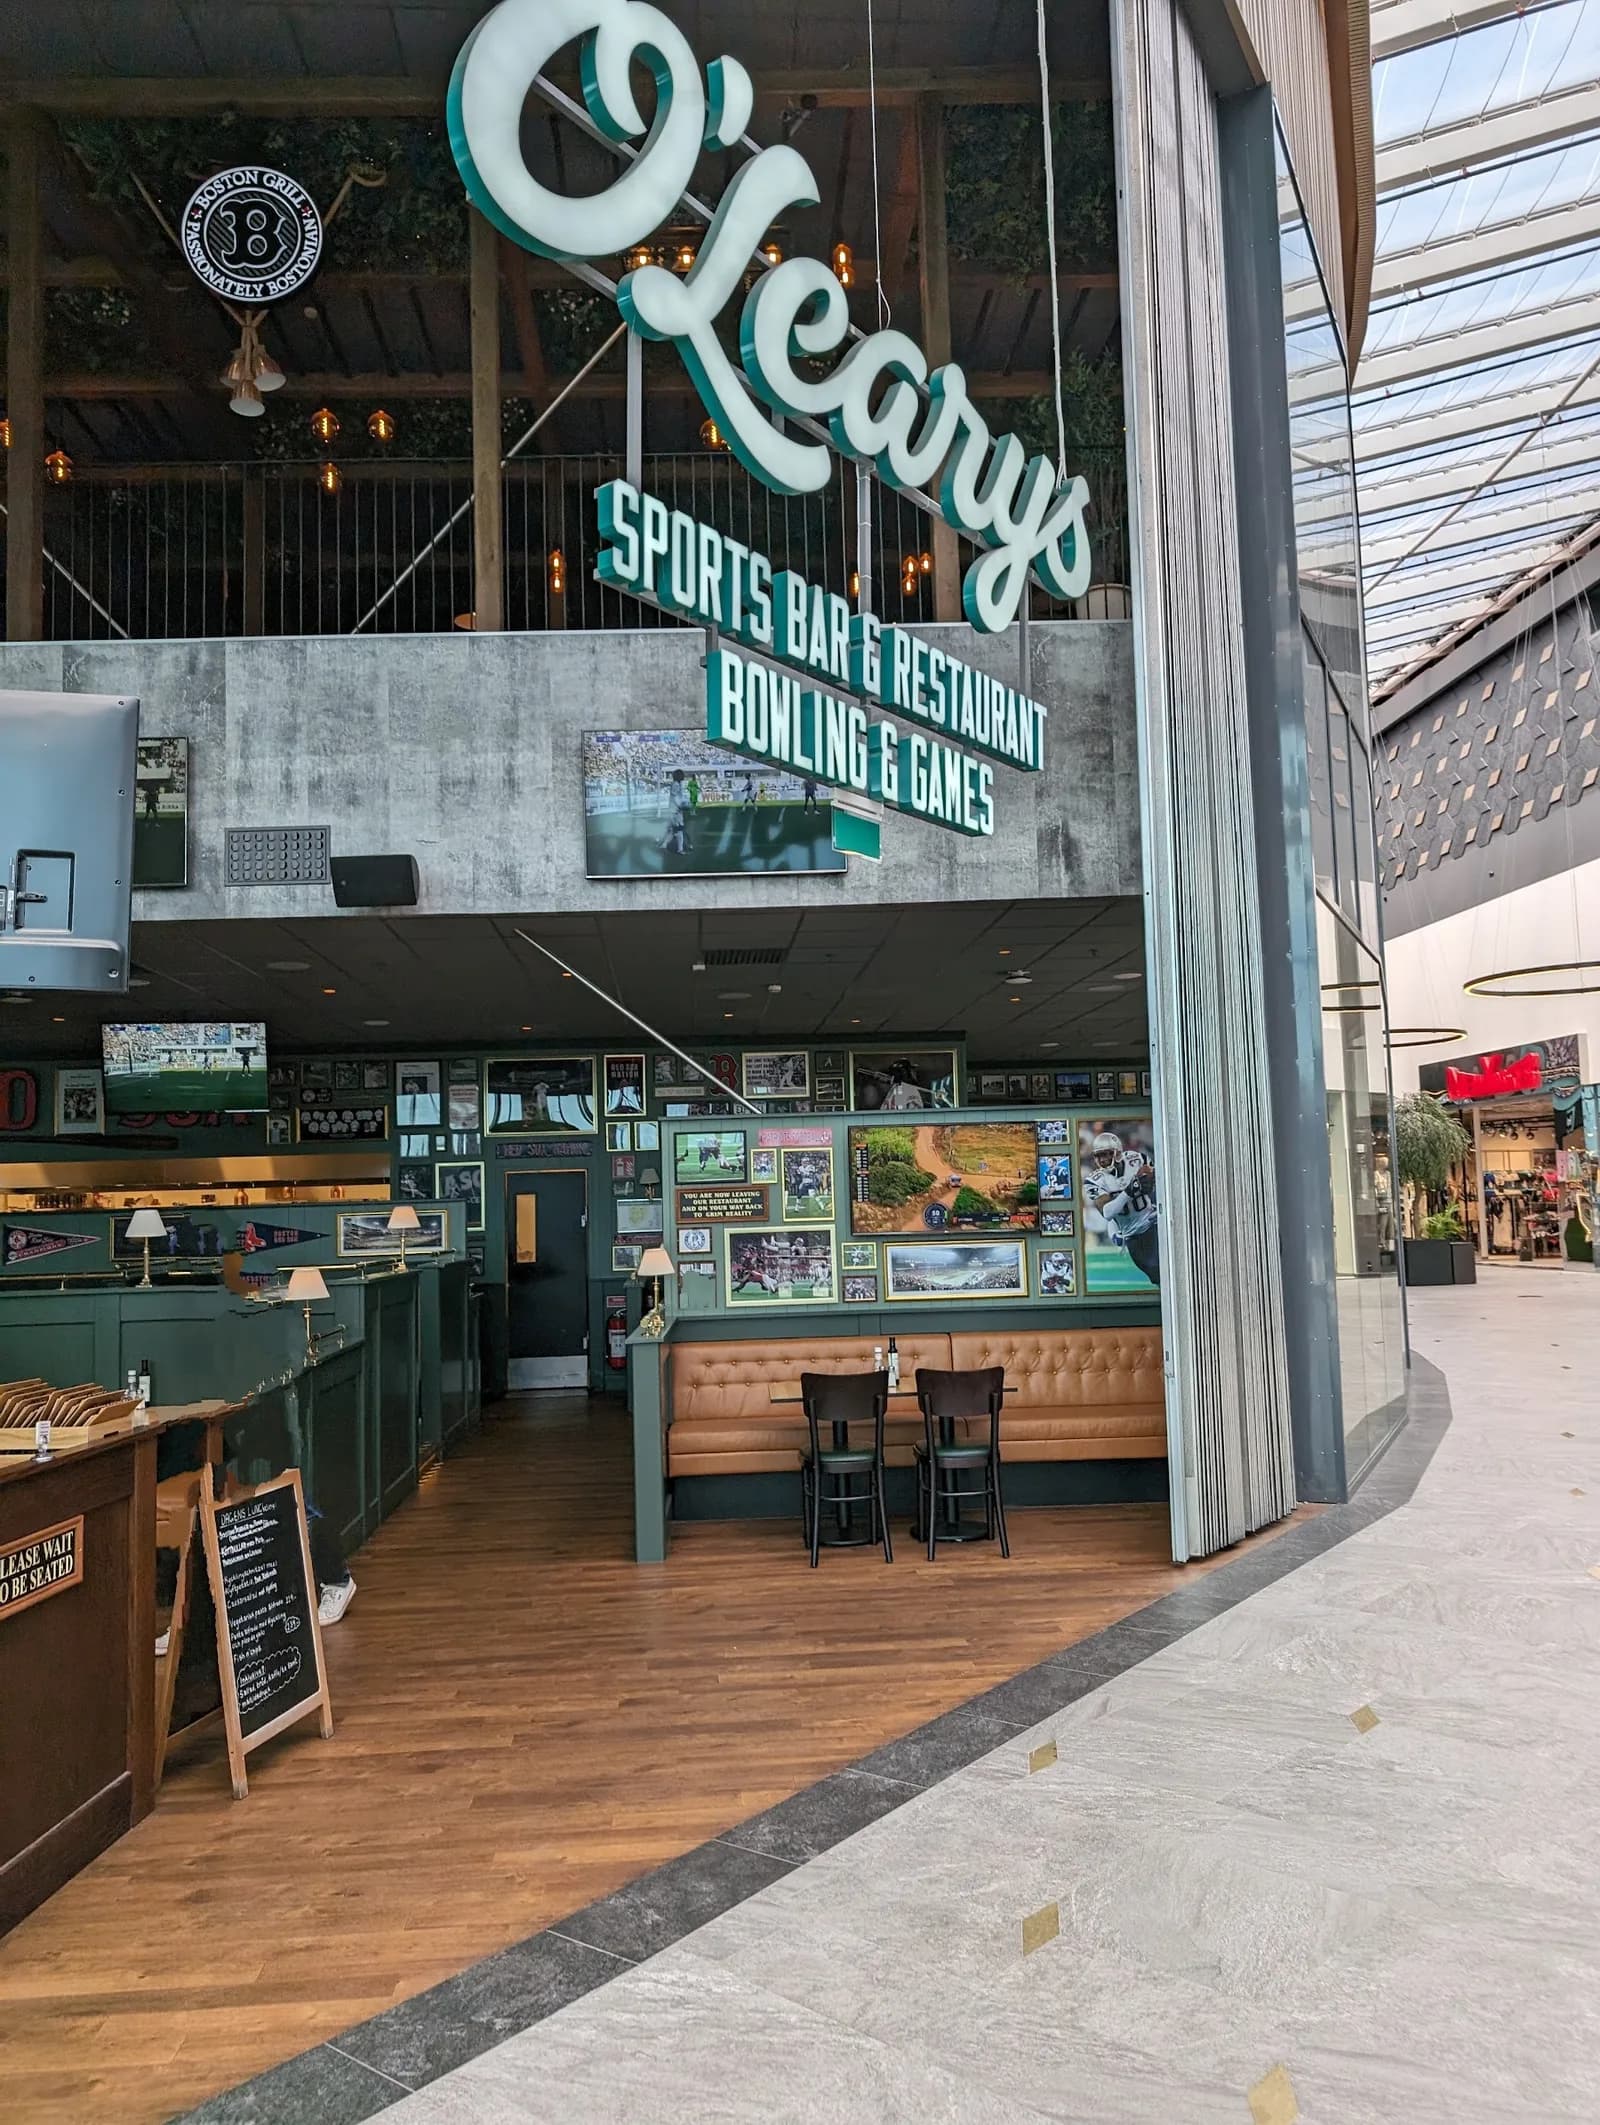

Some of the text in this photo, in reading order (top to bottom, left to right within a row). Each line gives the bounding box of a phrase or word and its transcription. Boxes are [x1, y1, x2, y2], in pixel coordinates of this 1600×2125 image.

[196, 171, 306, 209] BOSTON GRILL
[186, 218, 318, 297] PASSIONATELY BOSTONIAN
[447, 0, 1091, 634] O'Learys
[606, 478, 1047, 771] SPORTS BAR & RESTAURANT
[715, 648, 994, 836] BOWLING & GAMES
[12, 1573, 27, 1599] BE
[30, 1554, 73, 1590] SEATED
[43, 1531, 73, 1560] WAIT
